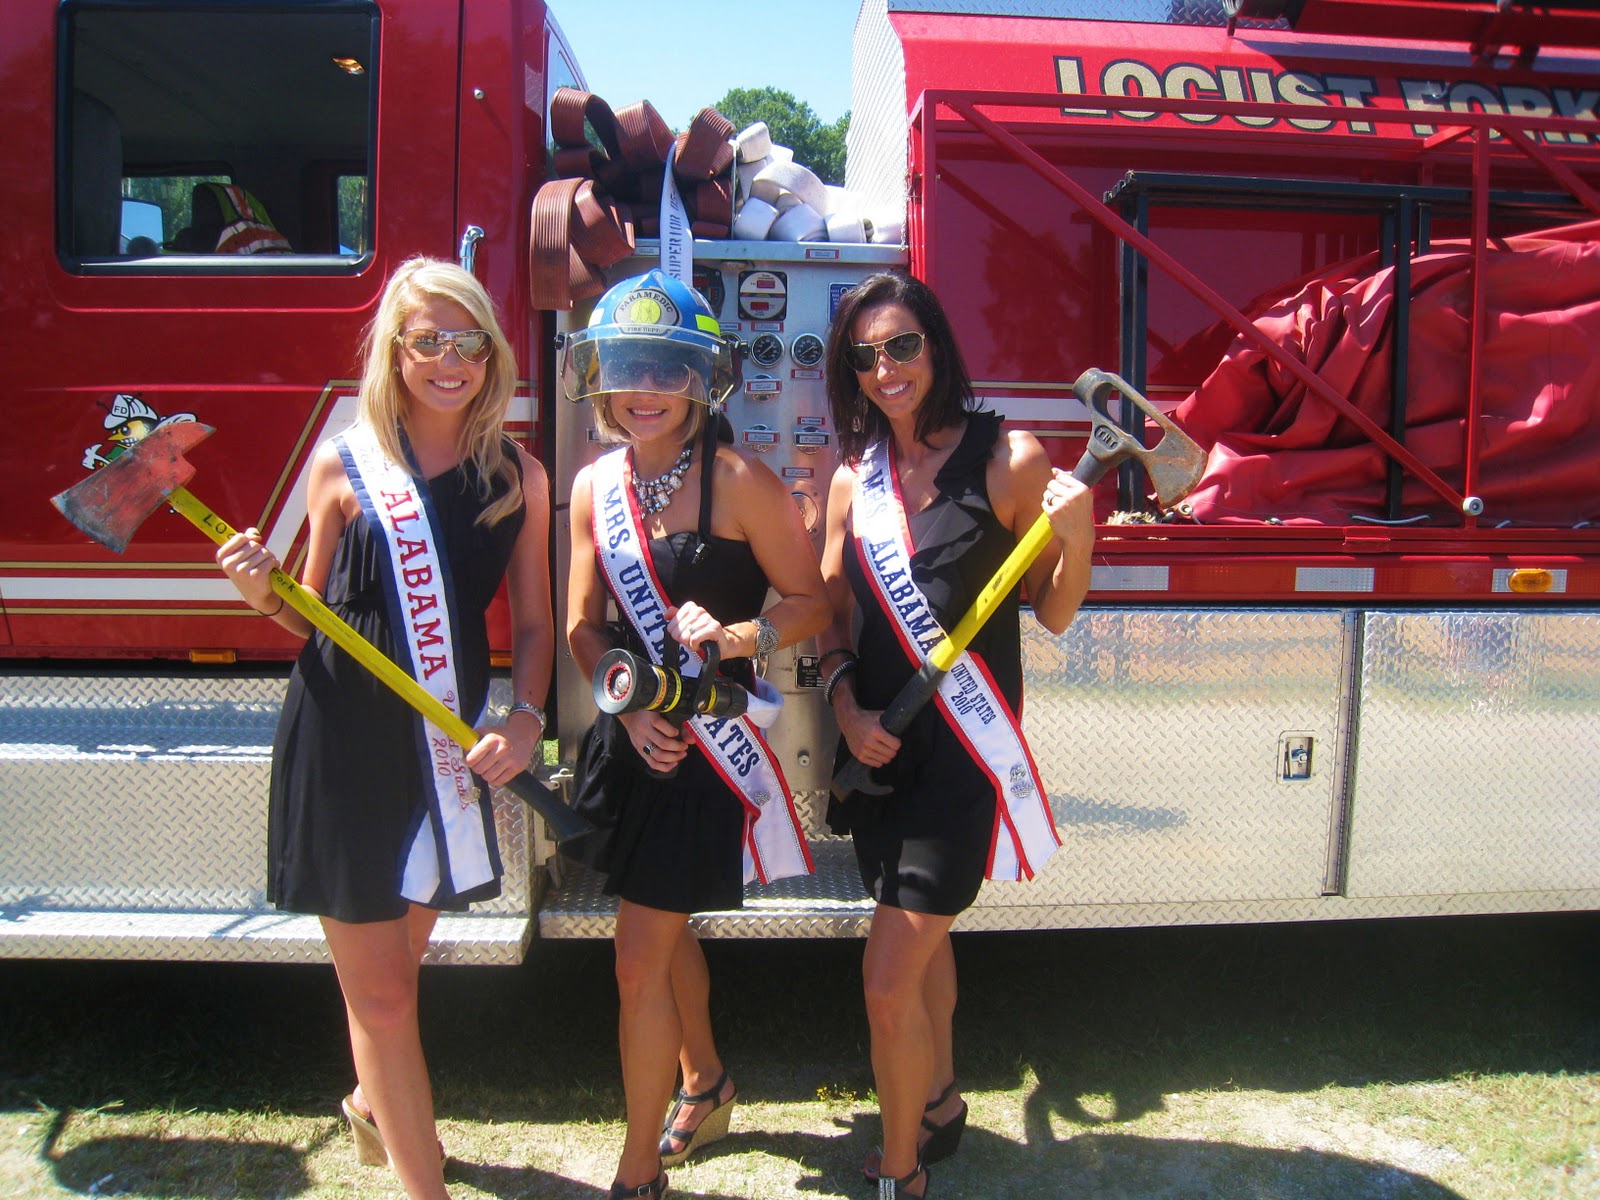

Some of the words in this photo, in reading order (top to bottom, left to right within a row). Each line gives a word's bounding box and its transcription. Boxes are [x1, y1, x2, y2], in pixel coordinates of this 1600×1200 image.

[1053, 56, 1379, 135] LOCUST
[1397, 77, 1600, 146] FORK
[620, 291, 674, 314] PARAMEDIC
[114, 406, 128, 415] FD
[1097, 427, 1118, 448] TNT
[603, 483, 631, 560] MRS.
[380, 490, 448, 681] ALABAMA
[868, 537, 947, 656] ALABAMA
[950, 662, 978, 695] UNITED
[970, 692, 997, 725] STATES
[951, 691, 973, 716] 2010
[432, 737, 452, 777] 2010
[698, 714, 760, 777] ATES
